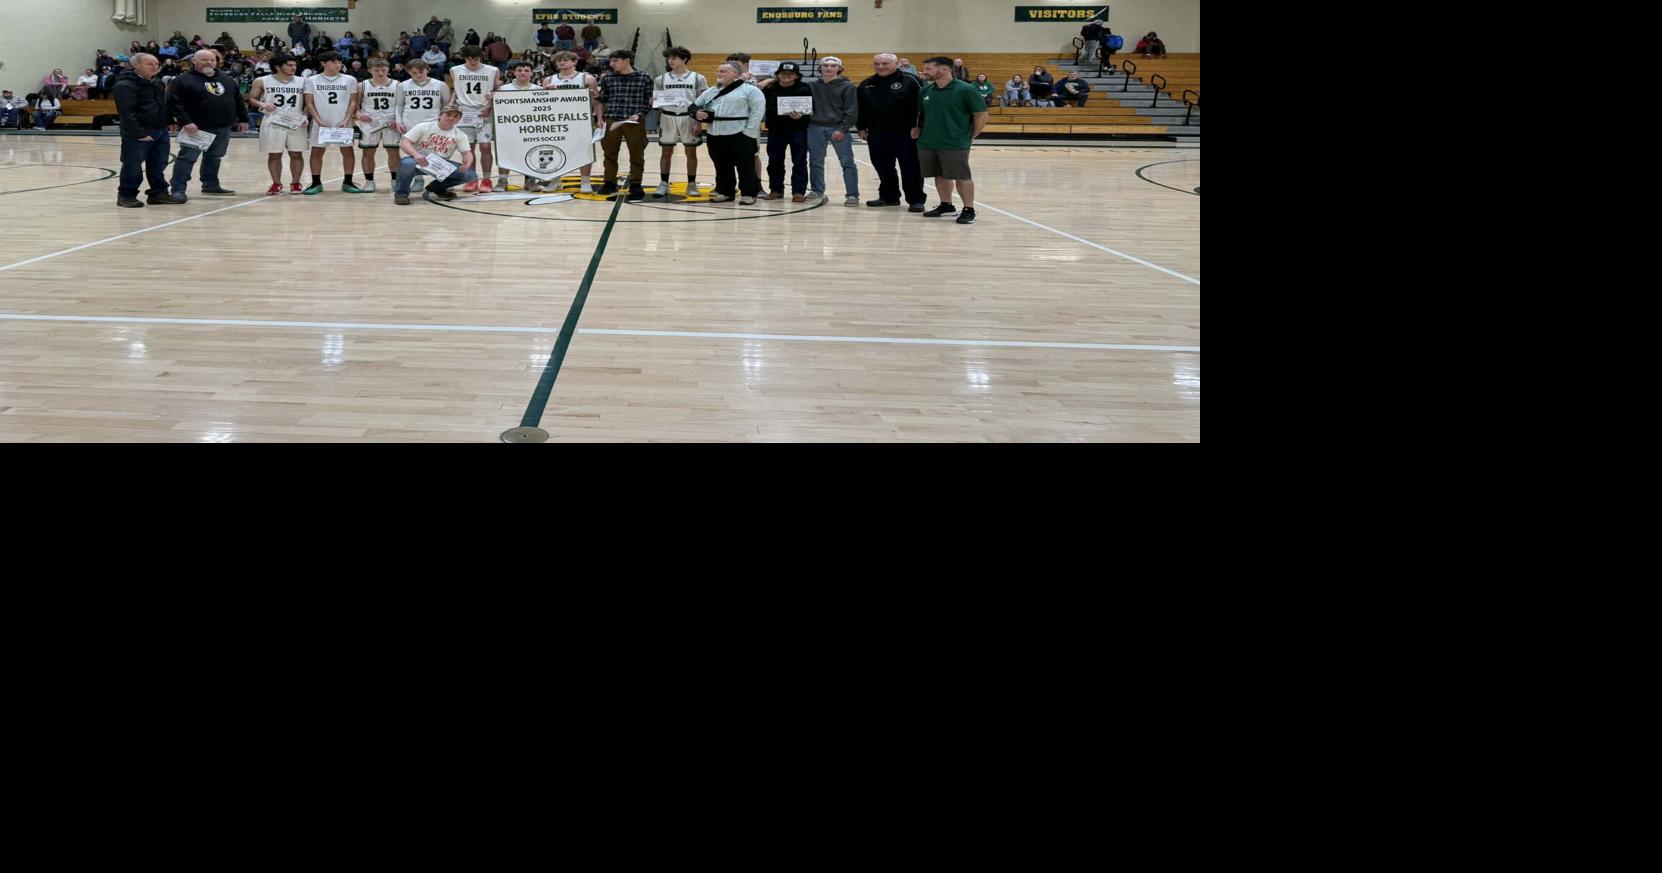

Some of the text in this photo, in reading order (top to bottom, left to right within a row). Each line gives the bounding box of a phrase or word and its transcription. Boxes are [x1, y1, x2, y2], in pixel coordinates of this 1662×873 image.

[1028, 10, 1094, 18] VISITORS
[466, 82, 482, 94] 14
[274, 94, 296, 107] 34
[328, 92, 338, 104] 2
[373, 98, 389, 110] 13
[410, 97, 433, 109] 33
[497, 112, 588, 123] ENOSBURG FALLS
[519, 124, 568, 134] HORNETS
